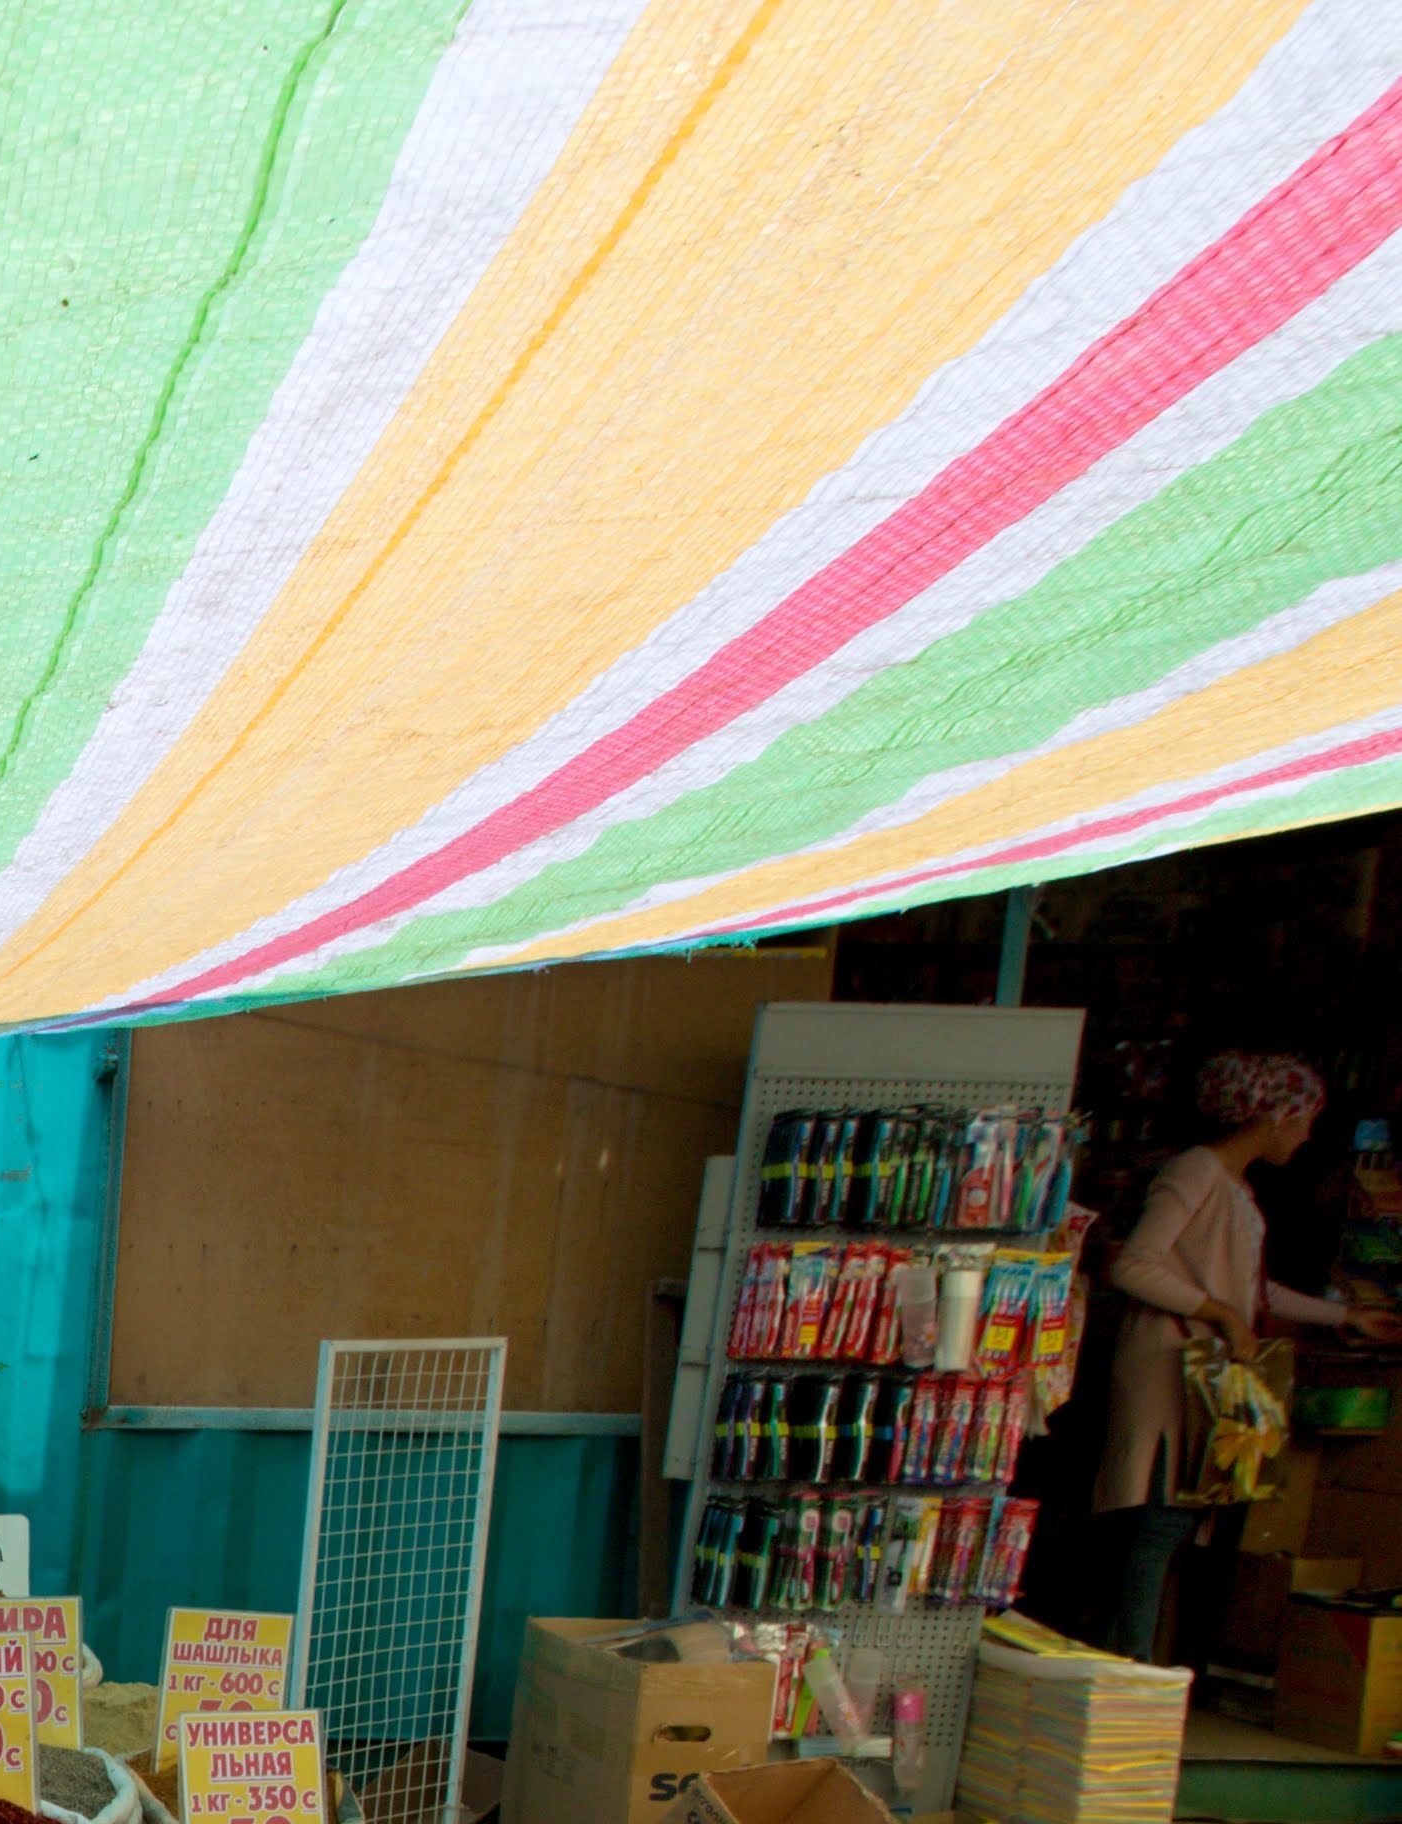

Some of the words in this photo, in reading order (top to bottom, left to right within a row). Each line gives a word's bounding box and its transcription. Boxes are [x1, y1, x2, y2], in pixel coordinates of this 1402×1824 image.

[204, 1618, 257, 1641] ДЛЯ
[173, 1643, 282, 1665] ШАШЛЫКА
[169, 1674, 177, 1690] 1
[220, 1672, 263, 1694] 600
[187, 1720, 314, 1746] УНИВЕРСА
[211, 1752, 291, 1777] ЛЬНАЯ
[192, 1795, 201, 1812] 1
[249, 1785, 296, 1810] 350
